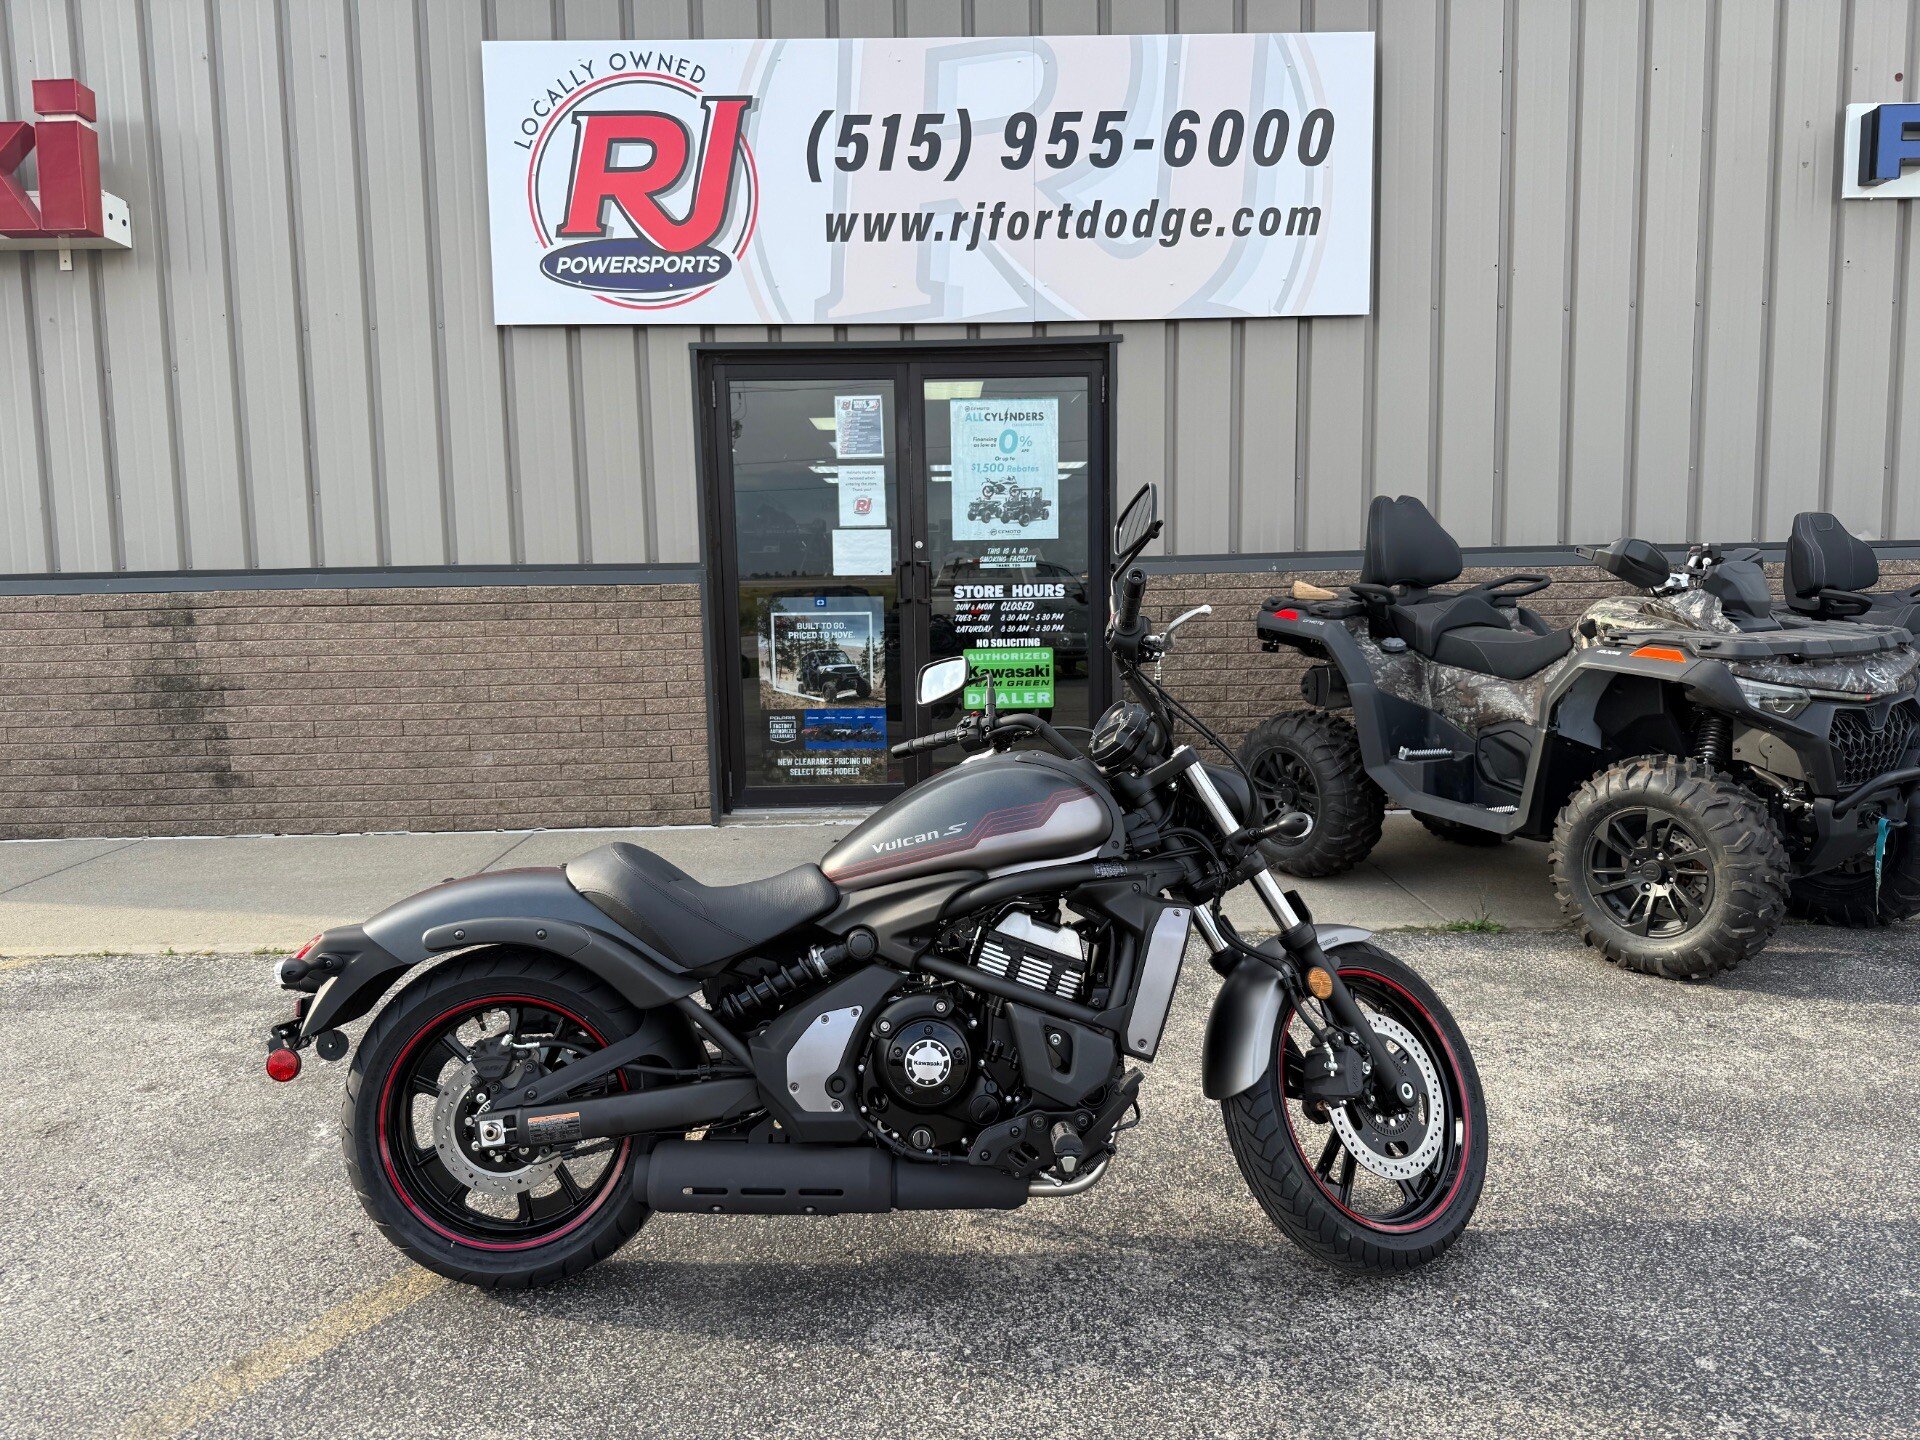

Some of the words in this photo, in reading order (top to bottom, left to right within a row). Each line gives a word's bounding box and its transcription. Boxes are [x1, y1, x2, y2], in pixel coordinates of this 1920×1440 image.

[514, 59, 595, 150] LOCALLY
[608, 50, 707, 84] OWNED
[805, 108, 973, 182] (515)
[1000, 107, 1336, 172] 955-6000
[556, 95, 758, 253] RJ
[824, 198, 1322, 252] www.rjfortdodge.com
[556, 254, 721, 275] POWERSPORTS
[971, 463, 1005, 474] $1,500
[1006, 464, 1040, 473] Rebates
[979, 555, 1007, 563] SMOKING
[1009, 554, 1037, 562] FACILITY
[953, 584, 1004, 598] STORE
[1011, 583, 1065, 597] HOURS
[955, 603, 971, 611] SUN
[976, 602, 995, 611] MON
[1000, 601, 1035, 611] CLOSED
[1016, 613, 1030, 621] AM
[1051, 613, 1065, 621] PM
[796, 622, 820, 630] BUILT
[821, 622, 832, 630] TO
[833, 622, 847, 630] GO.
[955, 625, 994, 633] SATURDAY
[1051, 624, 1065, 632] PM
[788, 631, 818, 639] PRICED
[819, 631, 830, 639] TO
[831, 631, 856, 639] MOVE.
[976, 639, 988, 648] NO
[990, 638, 1041, 647] SOLICITING
[968, 652, 1050, 661] AUTHORIZED
[969, 664, 1050, 679] Kawasaki
[777, 758, 794, 766] NEW
[794, 757, 833, 766] CLEARANCE
[834, 757, 861, 765] PRICING
[861, 757, 872, 765] ON
[789, 768, 815, 776] SELECT
[815, 767, 833, 776] 2025
[833, 767, 860, 775] MODELS
[872, 830, 939, 854] Vulcan
[943, 821, 968, 836] S
